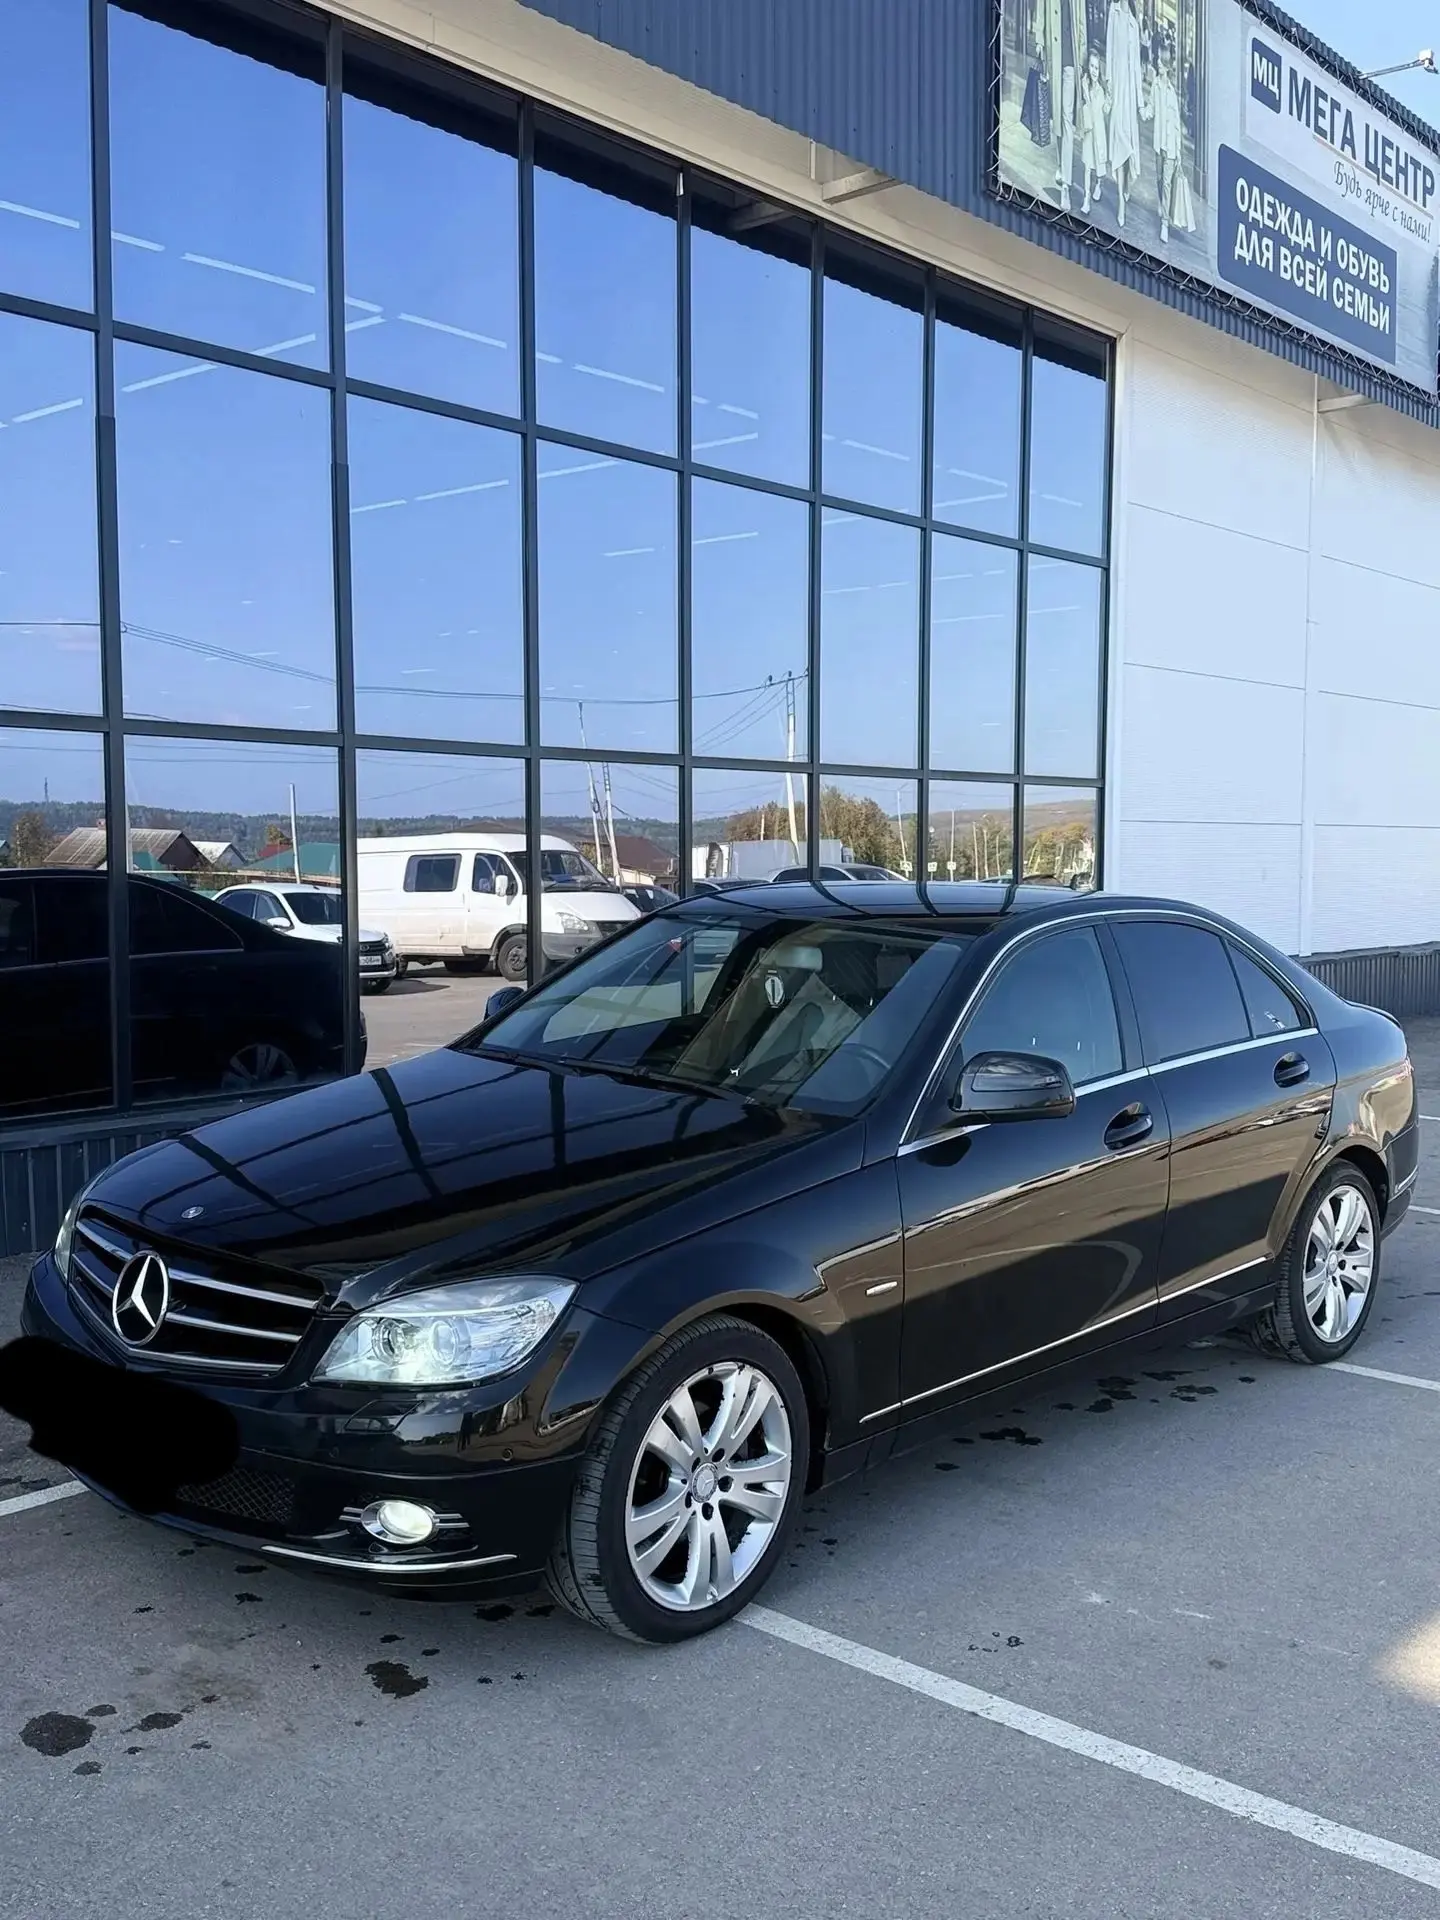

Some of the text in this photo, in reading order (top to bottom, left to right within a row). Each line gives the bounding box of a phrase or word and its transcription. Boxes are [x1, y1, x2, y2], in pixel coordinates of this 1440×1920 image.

[1254, 52, 1279, 100] МЦ
[1288, 67, 1435, 208] МЕГА ЦЕНТР
[1236, 177, 1390, 294] ОДЕЖДА И ОБУВЬ
[1334, 161, 1431, 243] Будь ярче с нами!
[1234, 223, 1390, 334] ДЛЯ ВСЕЙ СЕМЬИ
